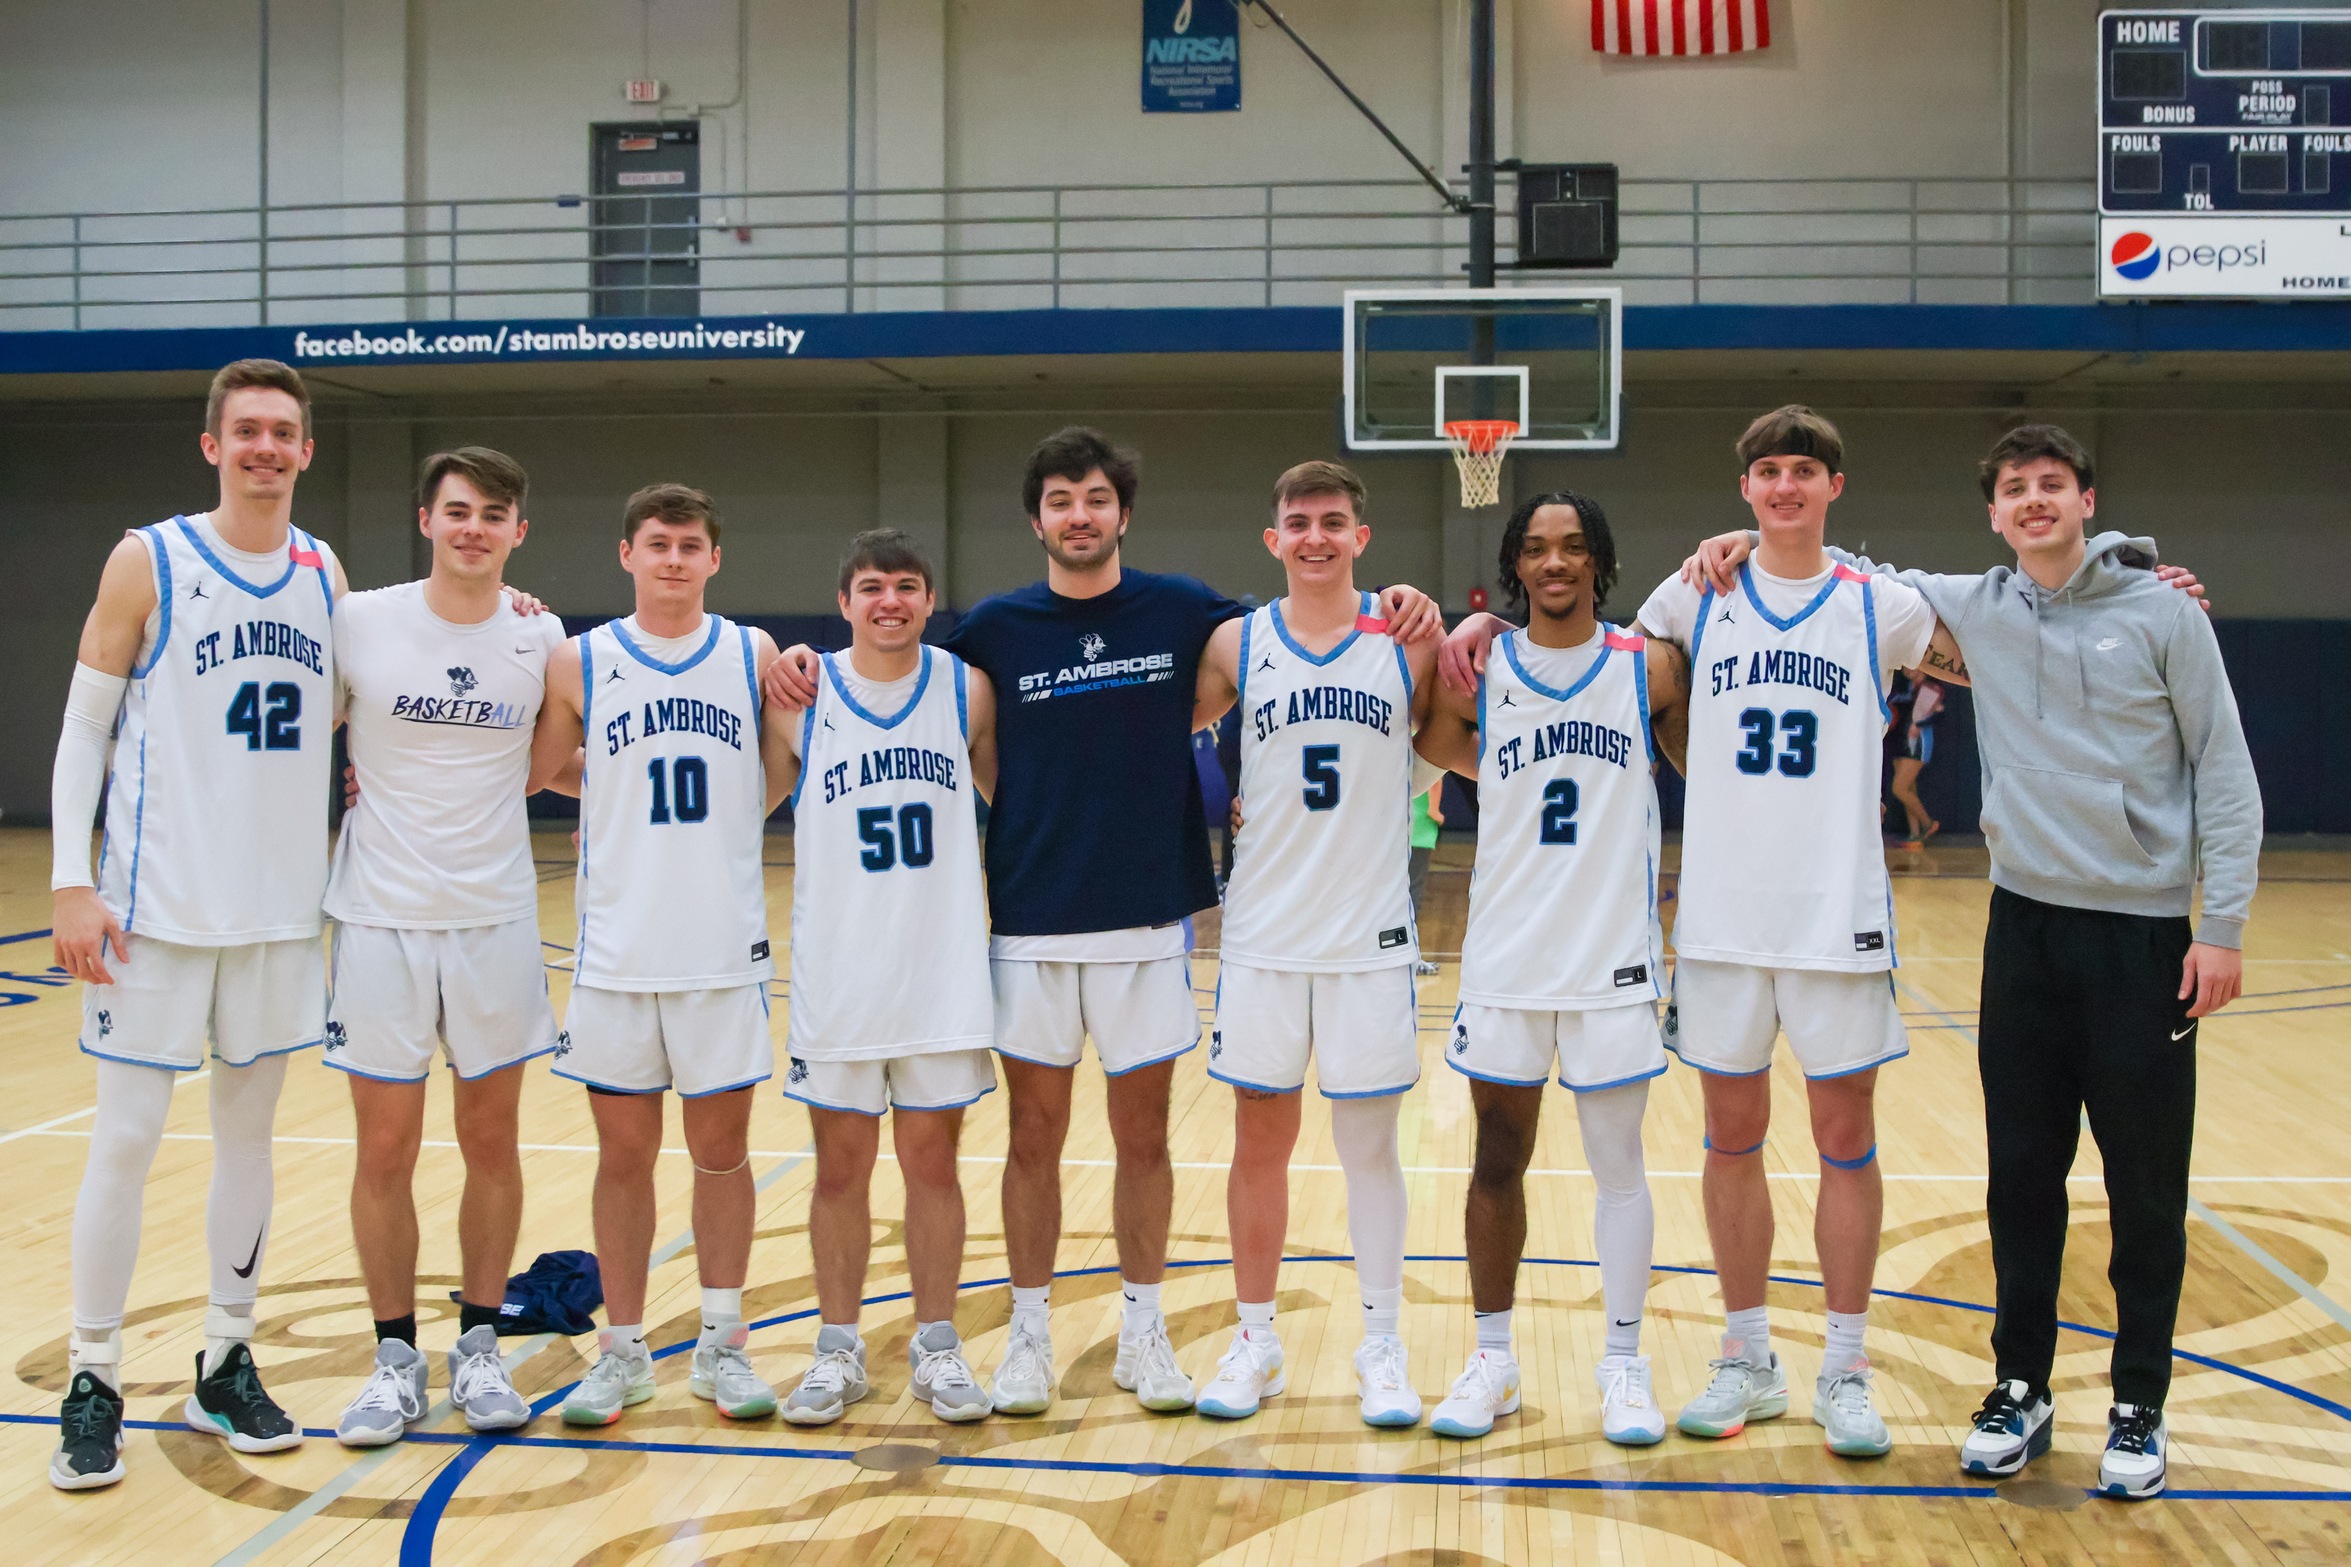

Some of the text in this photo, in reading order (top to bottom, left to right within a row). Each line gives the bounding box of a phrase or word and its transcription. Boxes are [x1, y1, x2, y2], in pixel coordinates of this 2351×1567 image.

[2117, 21, 2180, 43] HOME
[1145, 36, 1237, 63] NIRSA
[632, 82, 655, 98] EXIT
[2238, 94, 2297, 112] PERIOD
[2252, 80, 2283, 94] POSS
[2143, 106, 2196, 123] BONUS
[2111, 135, 2162, 151] FOULS
[2229, 134, 2288, 152] PLAYER
[2304, 134, 2351, 152] FOULS
[2184, 193, 2215, 210] TOL
[2167, 240, 2266, 272] pepsi
[2283, 276, 2351, 288] HOME
[295, 323, 805, 357] facebook.com/stambroseuniversity
[196, 620, 323, 676] ST. AMBROSE
[1018, 653, 1173, 691] ST. AMBROSE
[1053, 675, 1146, 697] BASKETBALL
[1711, 649, 1850, 706] ST. AMBROSE
[225, 681, 302, 751] 42
[391, 695, 526, 728] BASKETBALL
[606, 697, 742, 756] ST. AMBROSE
[1255, 686, 1392, 742] ST. AMBROSE
[1498, 720, 1632, 781] ST. AMBROSE
[1736, 706, 1818, 779] 33
[647, 755, 709, 825] 10
[824, 747, 956, 804] ST. AMBROSE
[1302, 743, 1341, 812] 5
[1539, 777, 1580, 845] 2
[856, 801, 935, 873] 50
